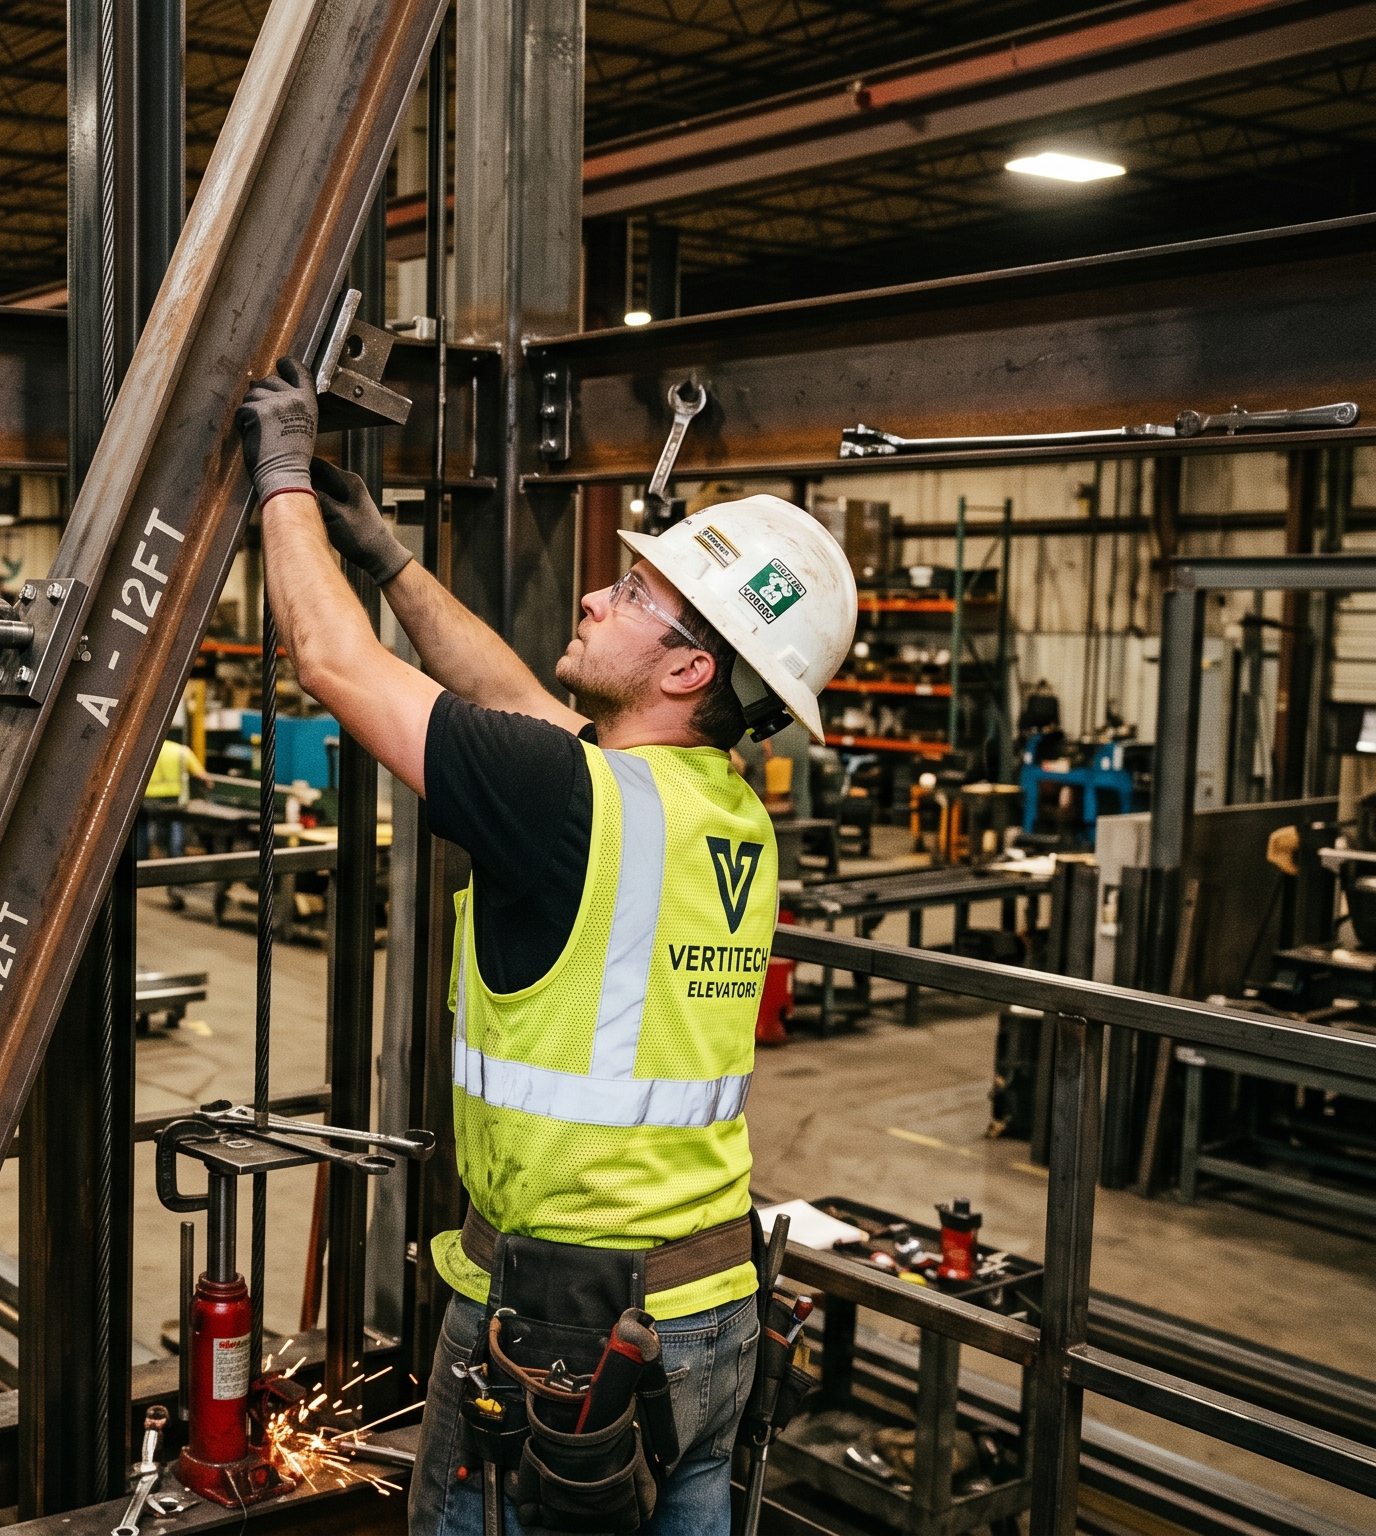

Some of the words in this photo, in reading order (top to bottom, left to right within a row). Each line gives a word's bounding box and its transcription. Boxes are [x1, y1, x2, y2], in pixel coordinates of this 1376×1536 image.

[111, 507, 185, 635] 12FT
[108, 650, 120, 670] -
[76, 693, 119, 727] A
[668, 944, 768, 972] VERTITECH
[687, 981, 757, 998] ELEVATORS
